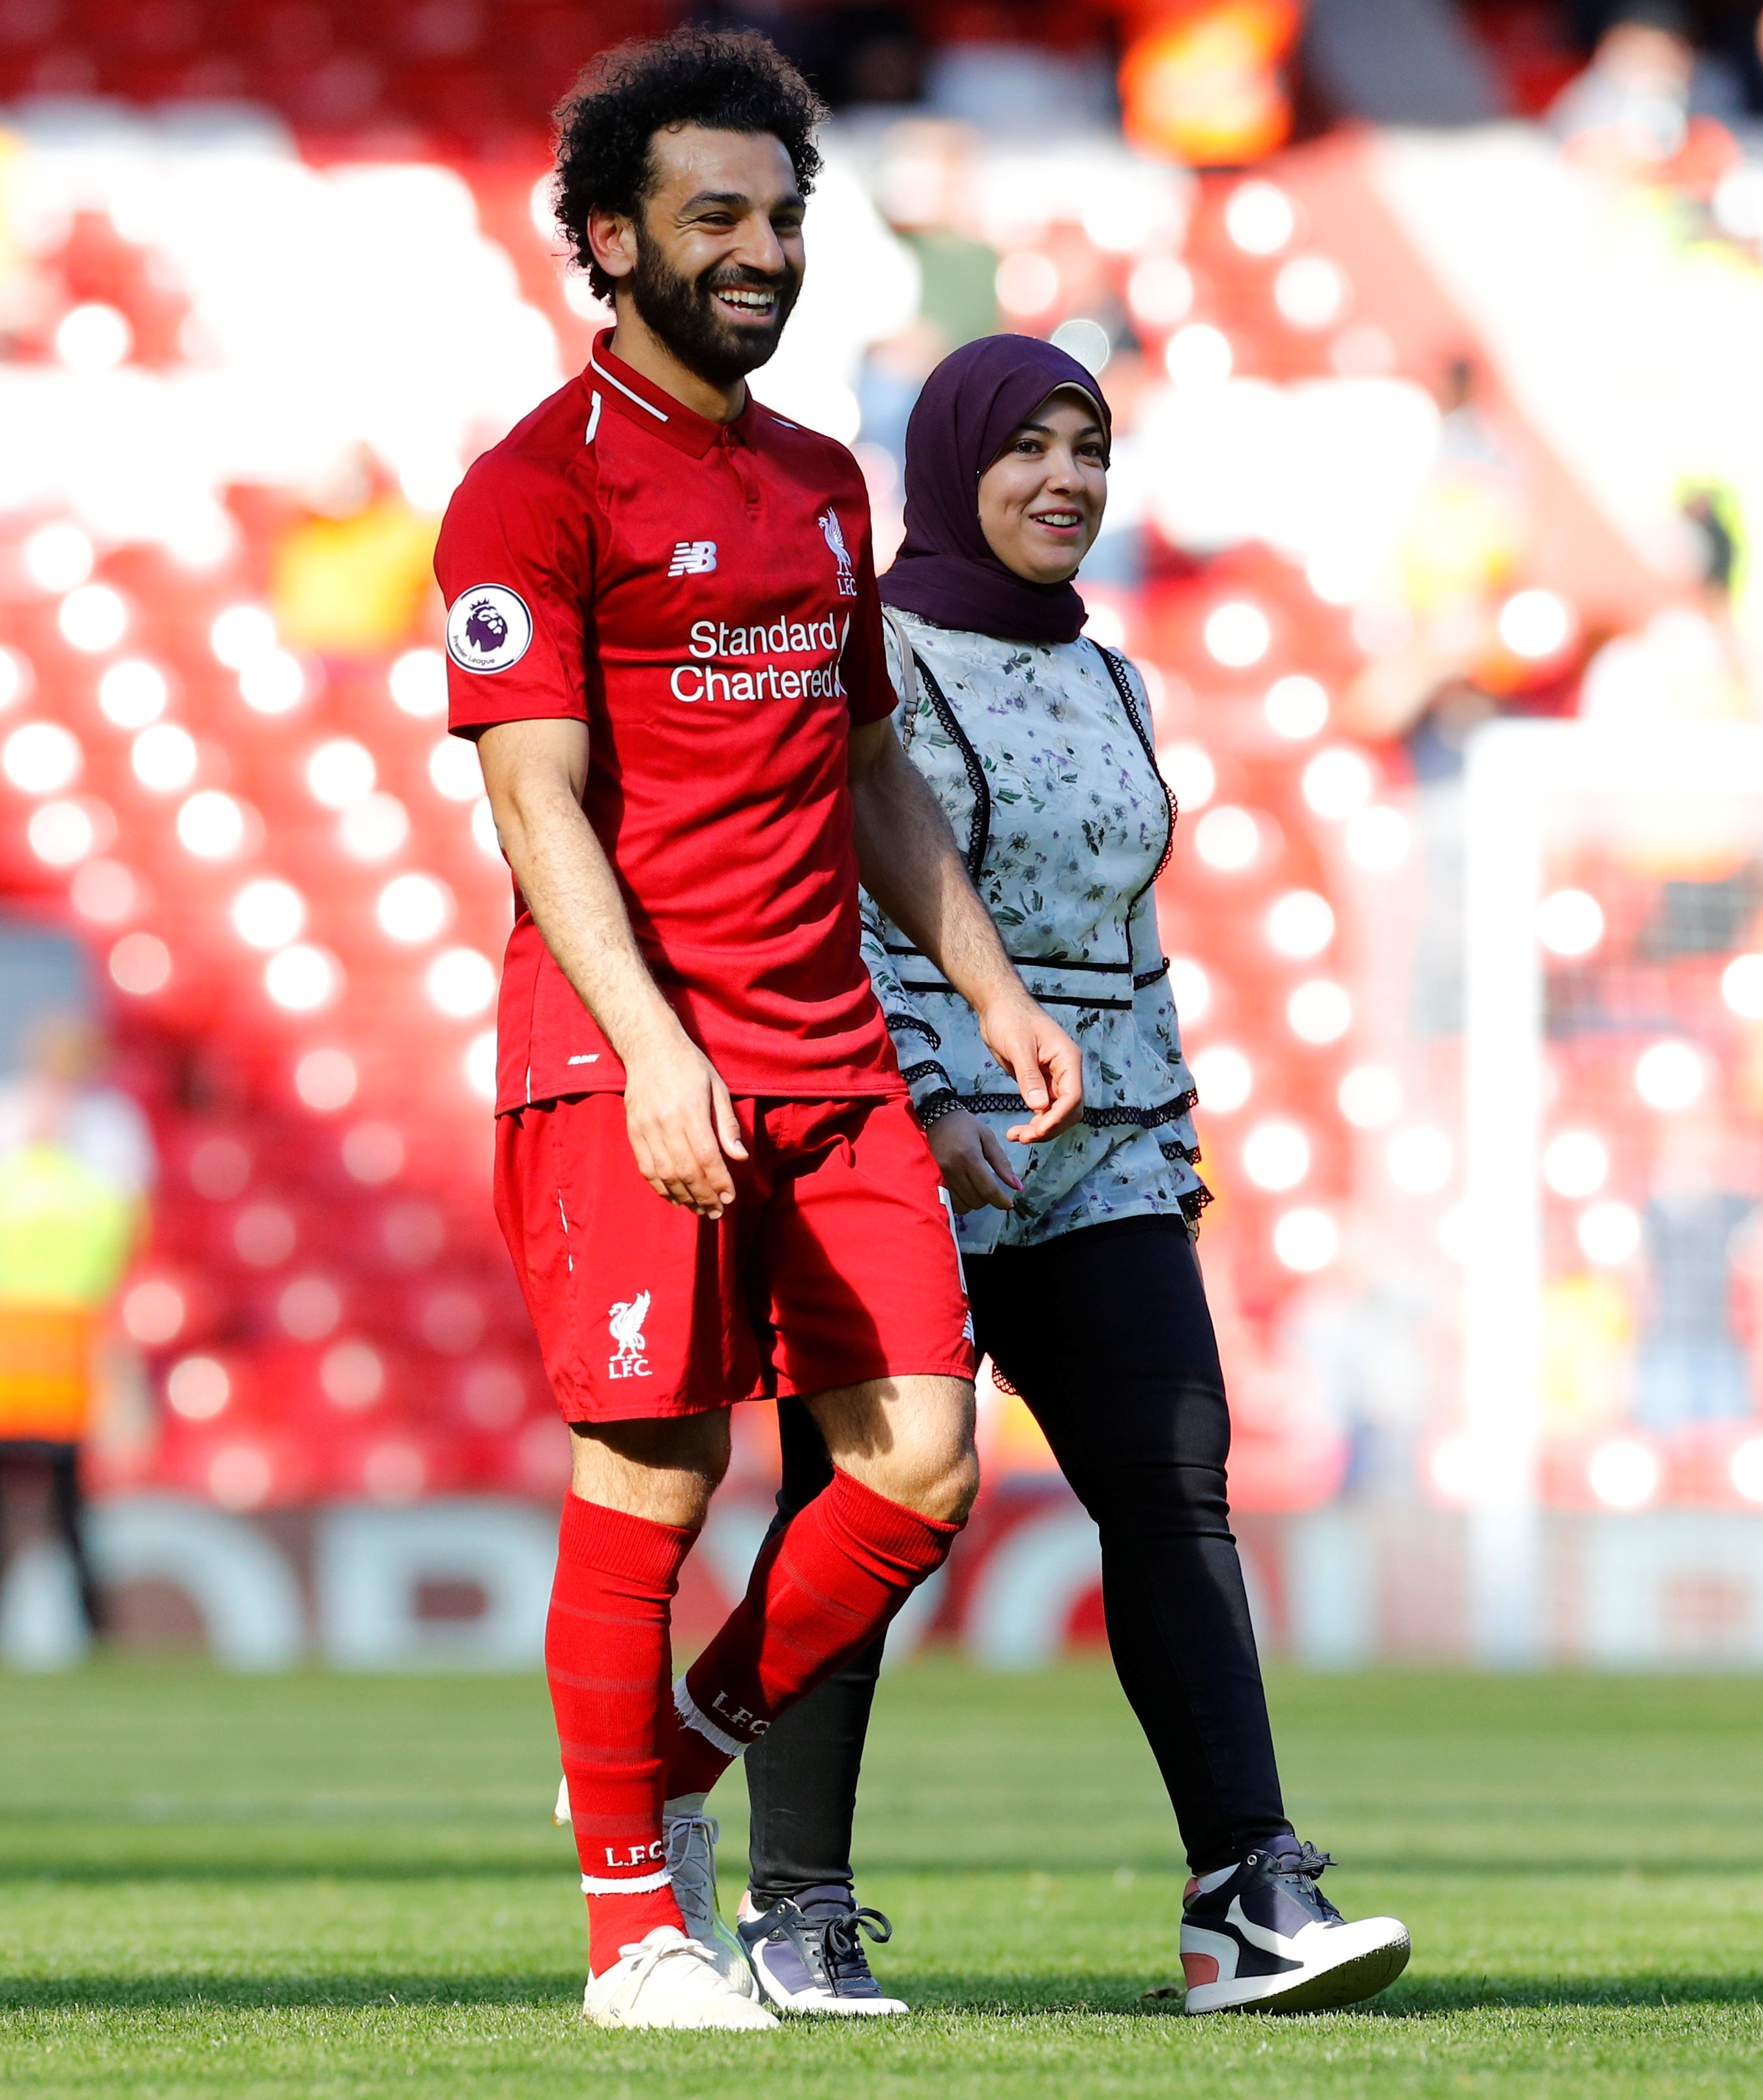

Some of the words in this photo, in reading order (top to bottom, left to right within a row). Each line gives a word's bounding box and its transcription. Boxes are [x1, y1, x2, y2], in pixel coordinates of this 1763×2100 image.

[453, 635, 467, 657] Premier
[469, 655, 495, 665] League
[688, 613, 838, 658] Standard
[670, 661, 834, 702] Chartered
[608, 1359, 652, 1378] L.F.C.
